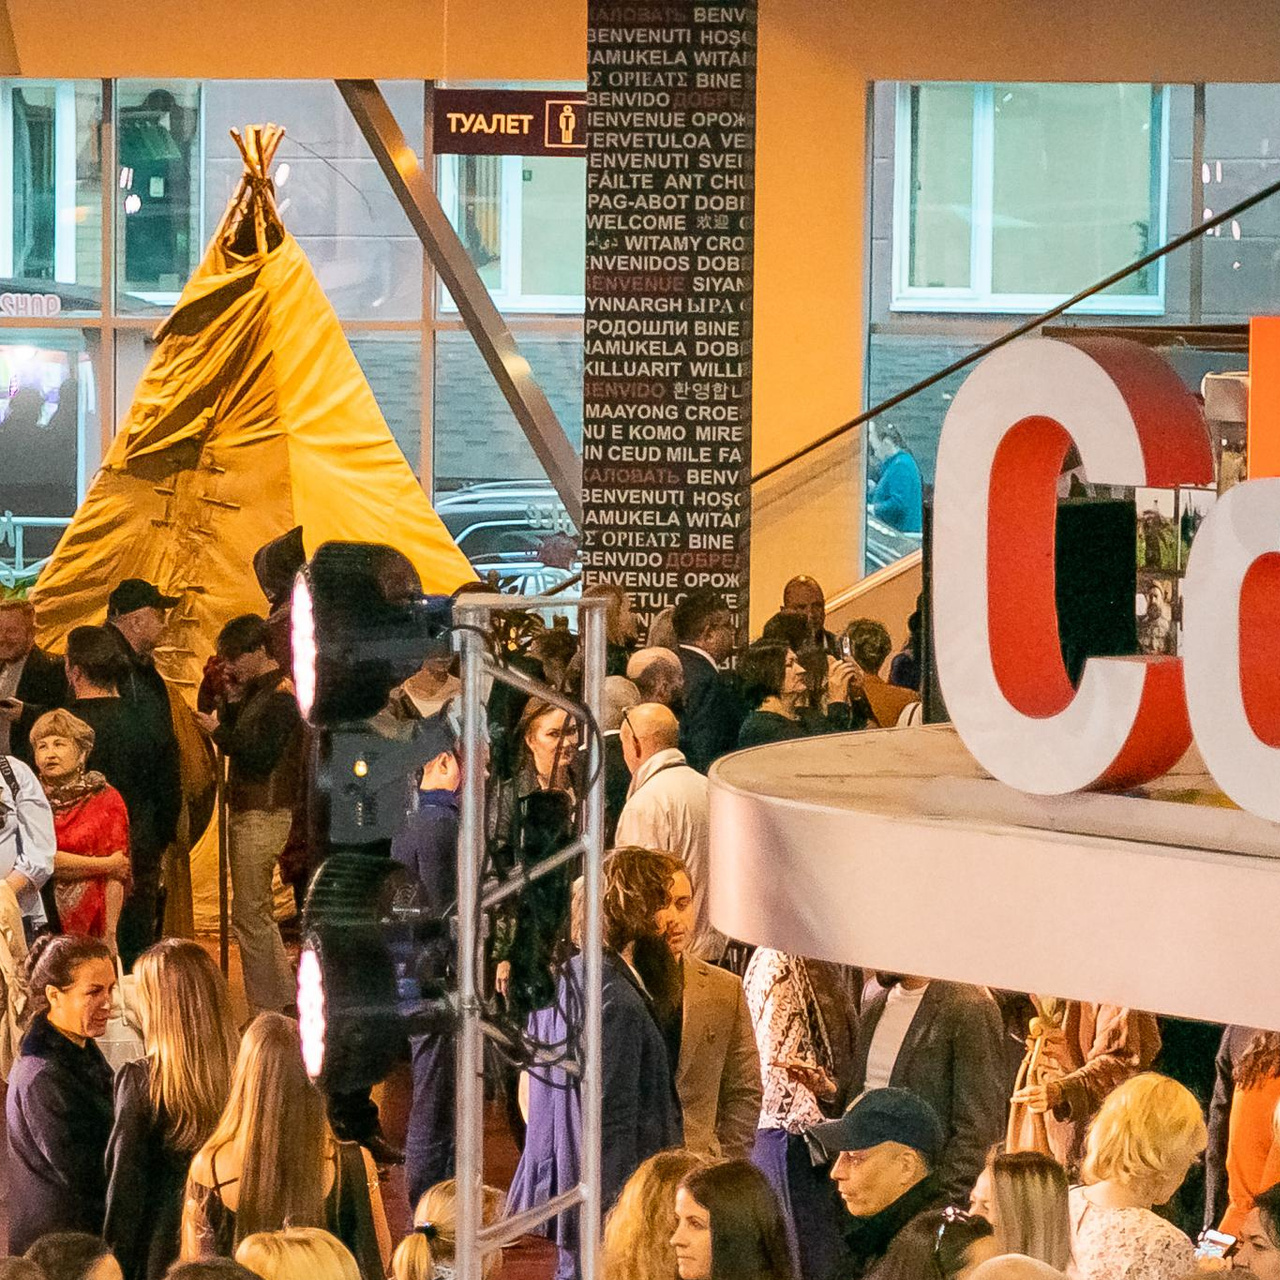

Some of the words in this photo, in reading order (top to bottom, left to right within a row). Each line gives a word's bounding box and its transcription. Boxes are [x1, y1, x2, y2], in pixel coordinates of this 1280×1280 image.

[587, 50, 687, 65] AMUKELA
[696, 74, 742, 88] BINE
[447, 113, 533, 134] ТУАЛЕТ
[586, 153, 688, 169] ENVENUTI
[664, 174, 705, 190] ANT
[588, 194, 690, 210] PAG-ABOT
[586, 214, 686, 230] WELCOME
[625, 235, 702, 251] WITAMY
[694, 321, 739, 336] BINE
[586, 404, 679, 419] MAAYONG
[630, 425, 686, 441] KOMO
[608, 446, 661, 461] CEUD
[667, 447, 712, 462] MILE
[582, 510, 680, 526] AMUKELA
[689, 534, 734, 549] BINE
